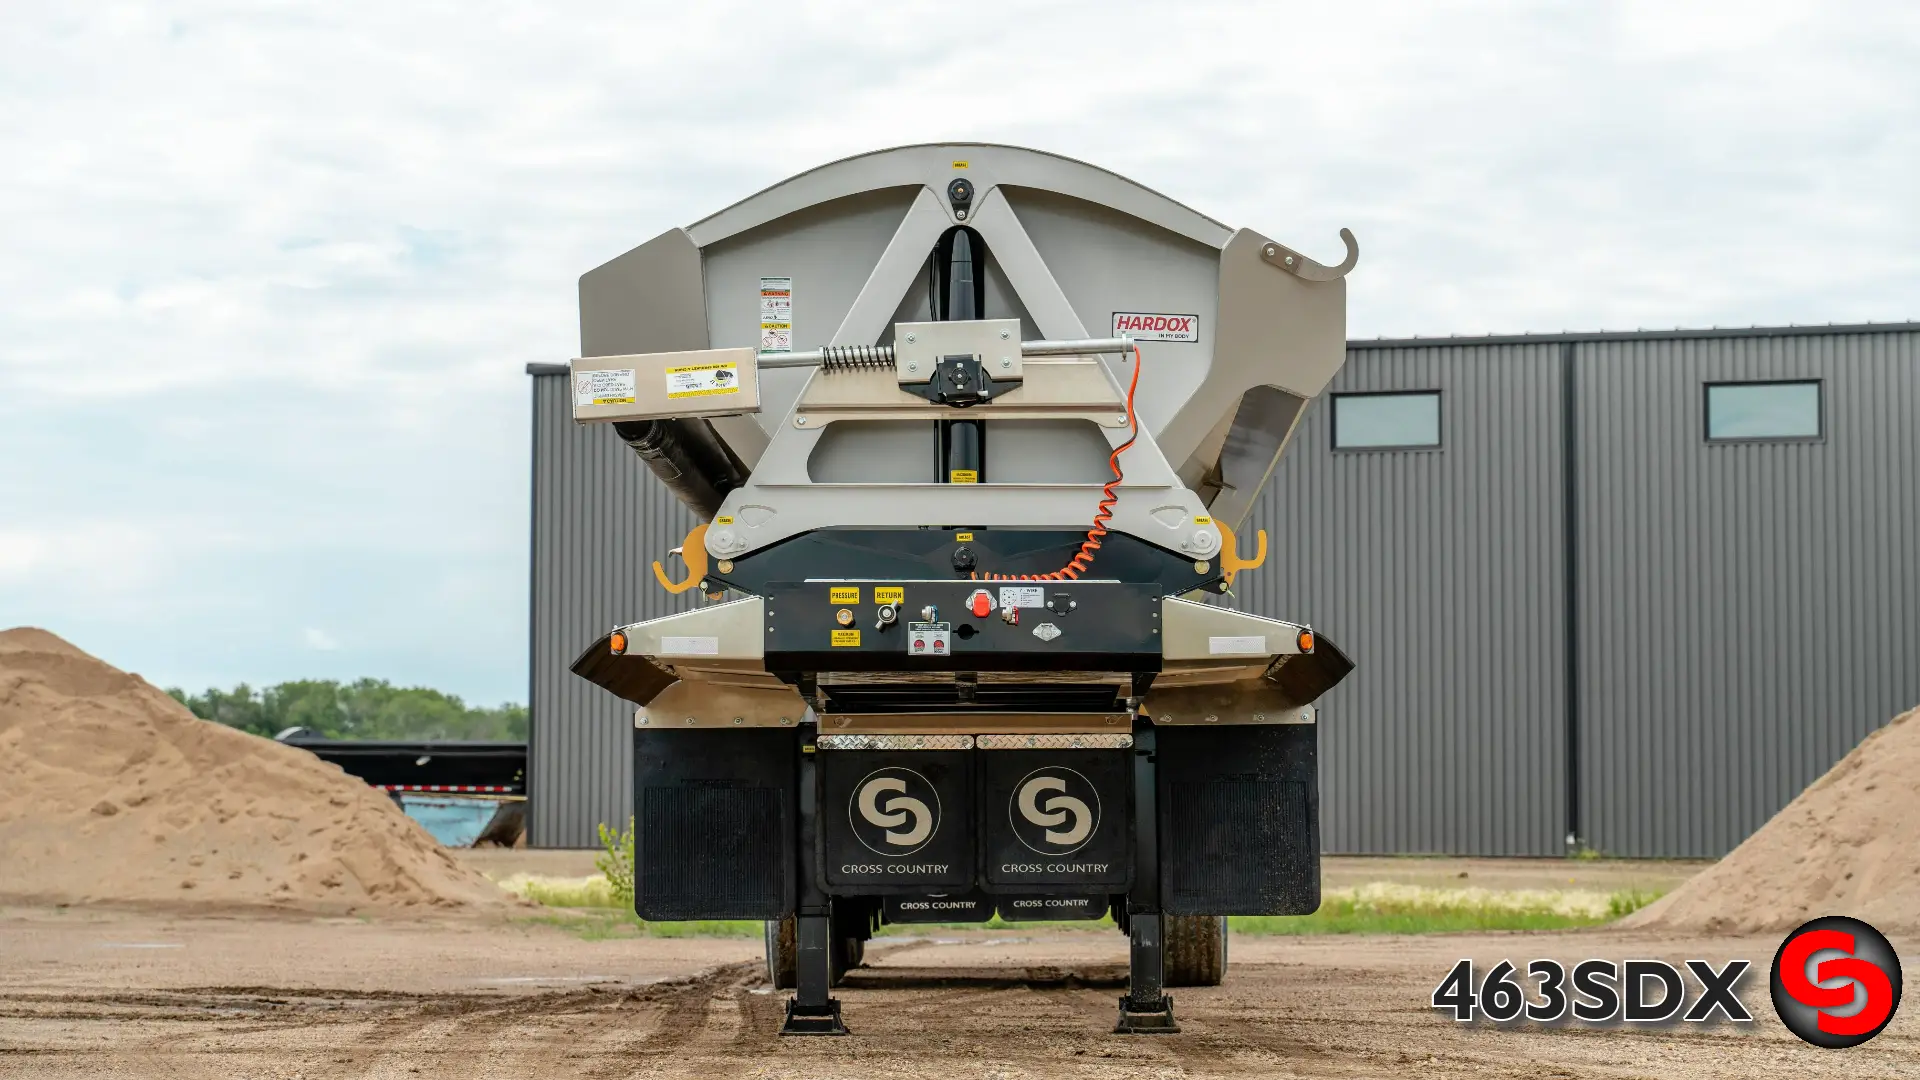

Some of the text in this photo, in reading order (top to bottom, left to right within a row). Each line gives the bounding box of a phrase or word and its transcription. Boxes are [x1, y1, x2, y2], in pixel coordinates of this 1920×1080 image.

[1117, 315, 1191, 332] HARDOX
[841, 864, 949, 874] CROSS COUNTRY
[1001, 863, 1109, 873] CROSS COUNTRY
[900, 901, 976, 910] CROSS COUNTRY
[1013, 899, 1089, 908] CROSS COUNTRY
